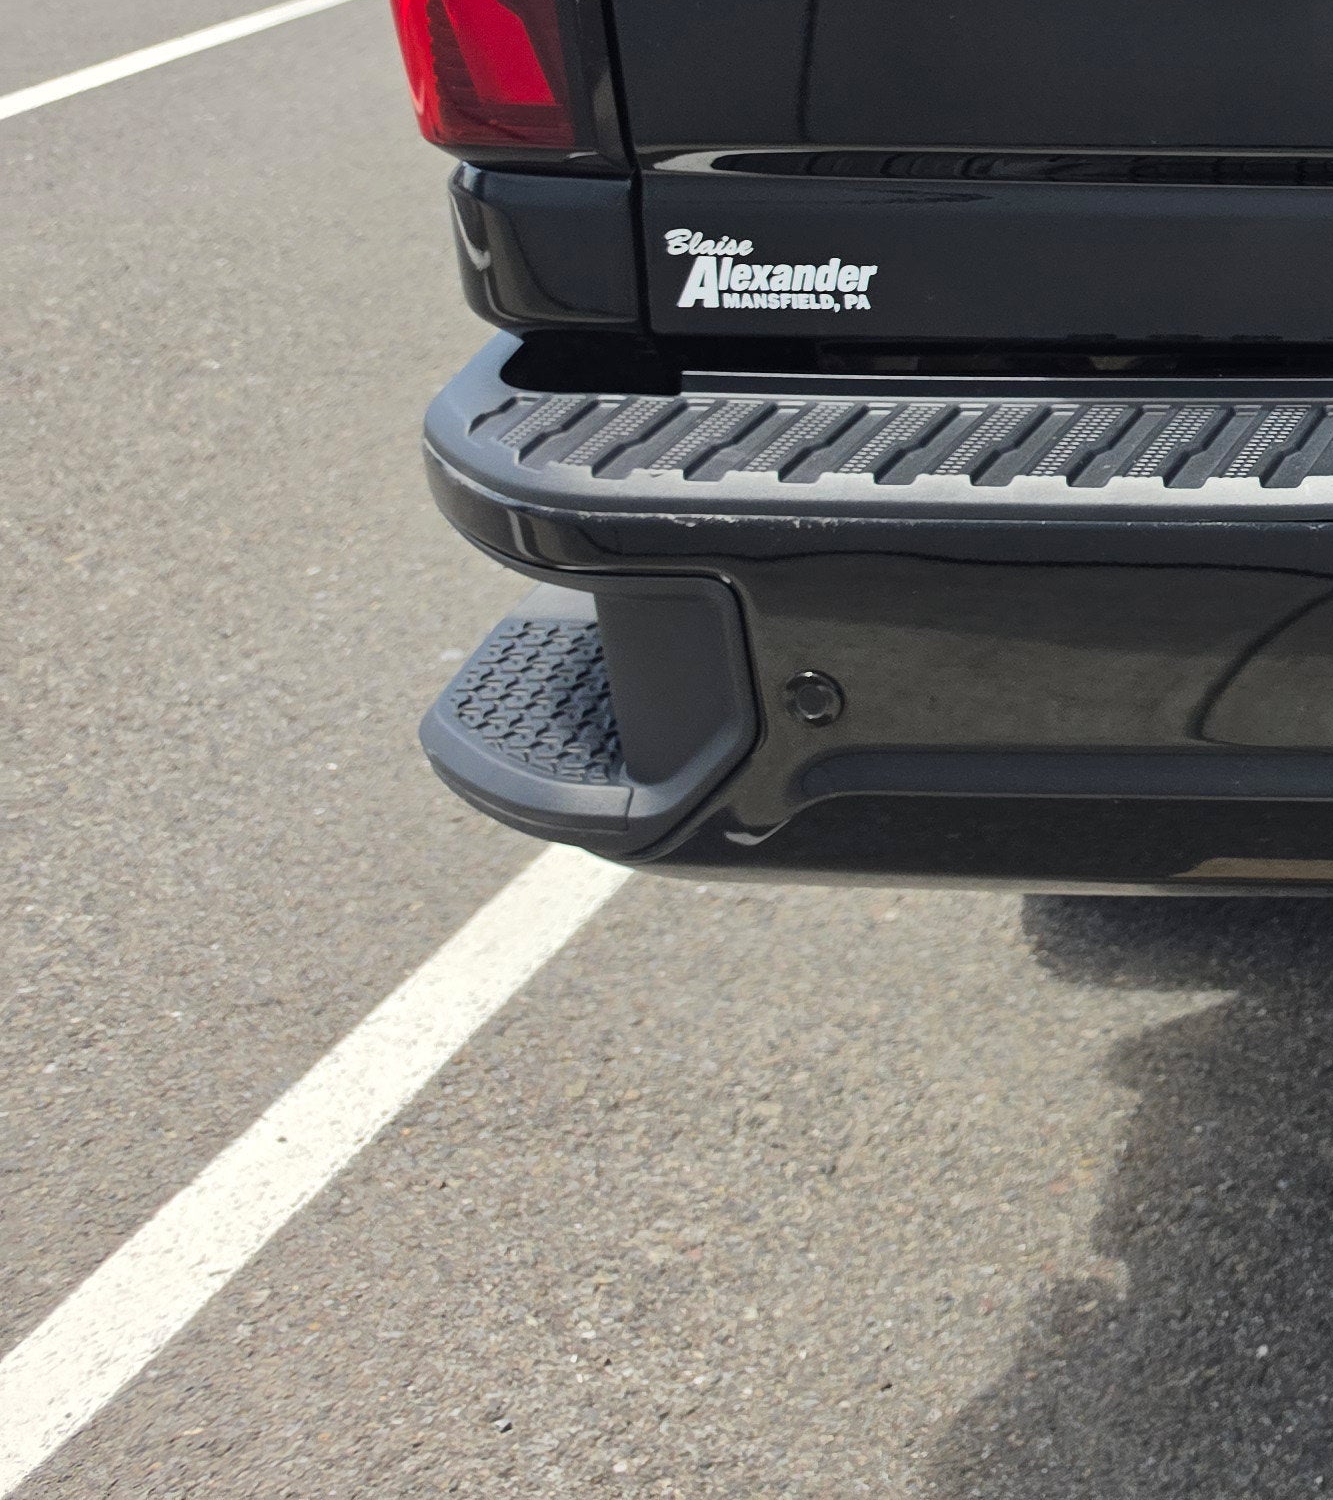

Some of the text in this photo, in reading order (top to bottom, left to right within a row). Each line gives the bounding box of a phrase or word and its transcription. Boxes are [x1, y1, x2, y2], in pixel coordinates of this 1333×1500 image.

[664, 228, 754, 256] Blaise
[676, 255, 878, 308] Alexander
[723, 293, 872, 313] MANSFIELD, PA
